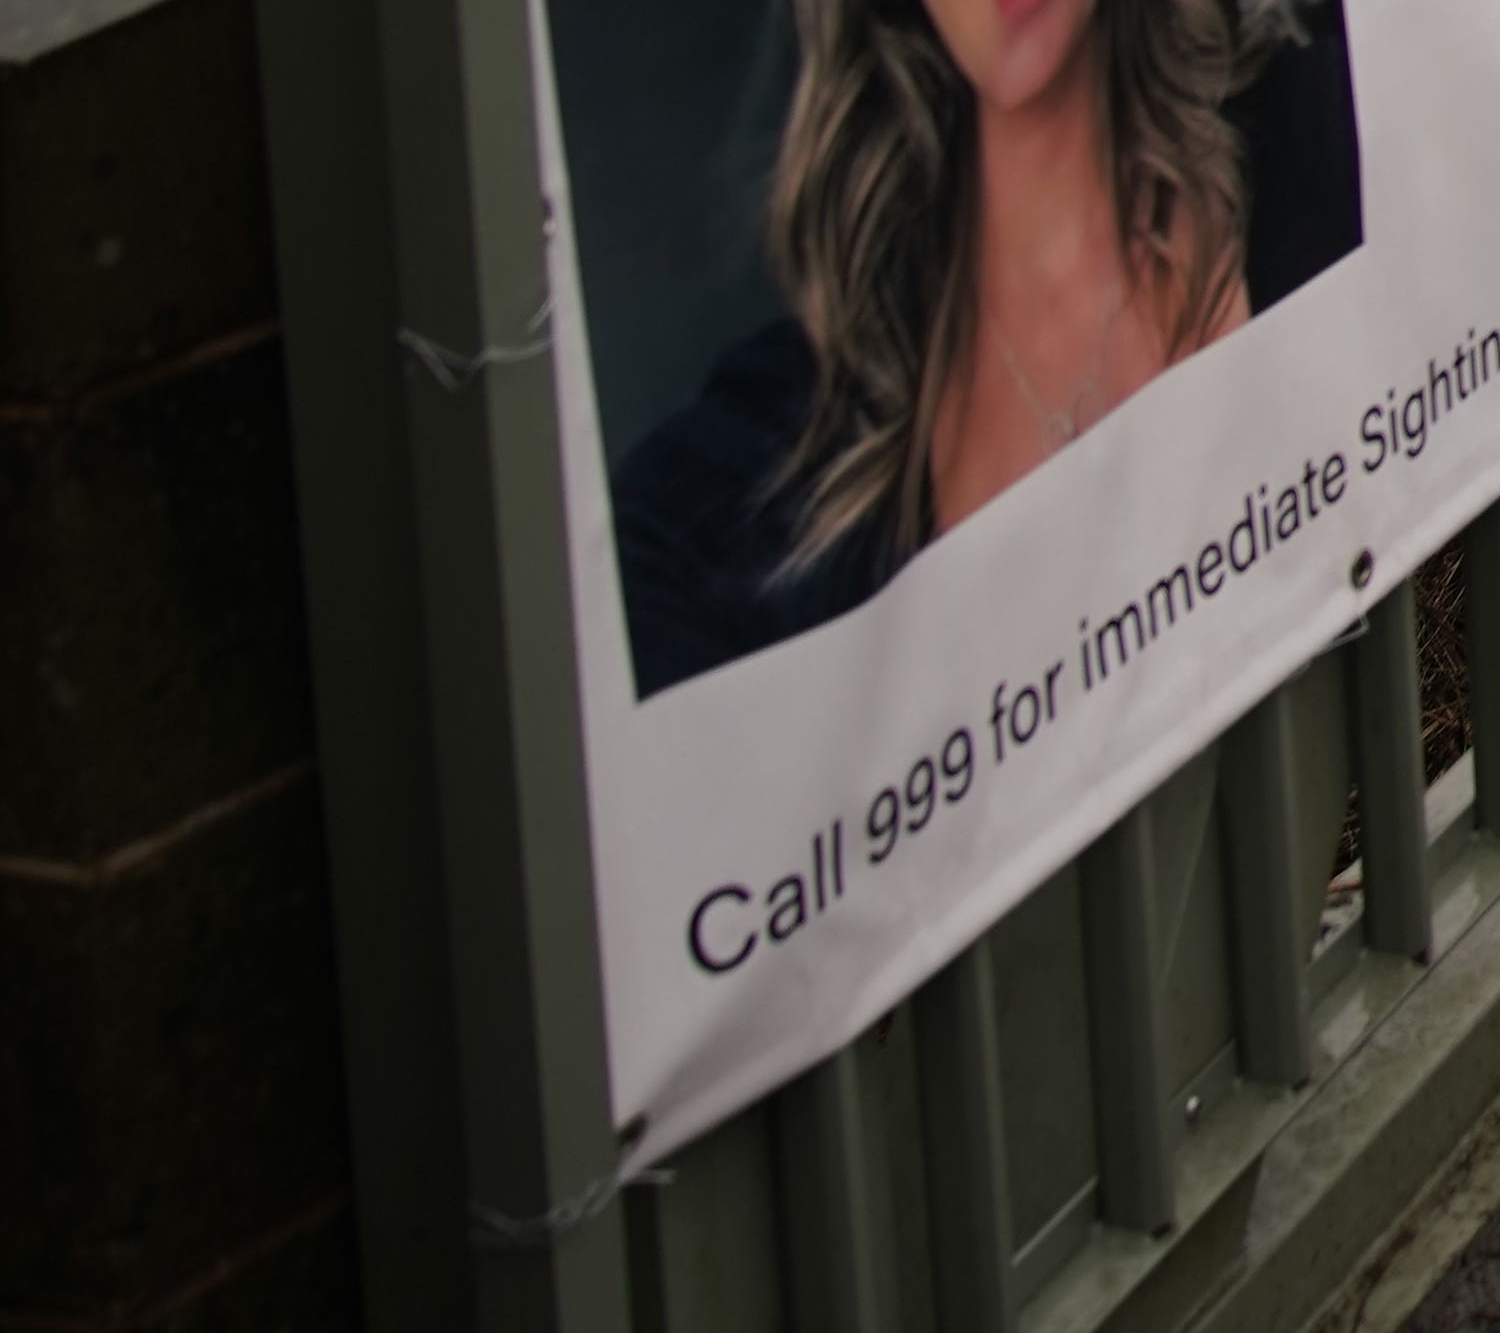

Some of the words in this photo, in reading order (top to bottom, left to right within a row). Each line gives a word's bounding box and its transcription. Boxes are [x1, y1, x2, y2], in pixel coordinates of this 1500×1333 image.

[686, 819, 845, 976] Call
[865, 726, 974, 866] 999
[987, 660, 1066, 762] for
[1079, 451, 1348, 691] immediate
